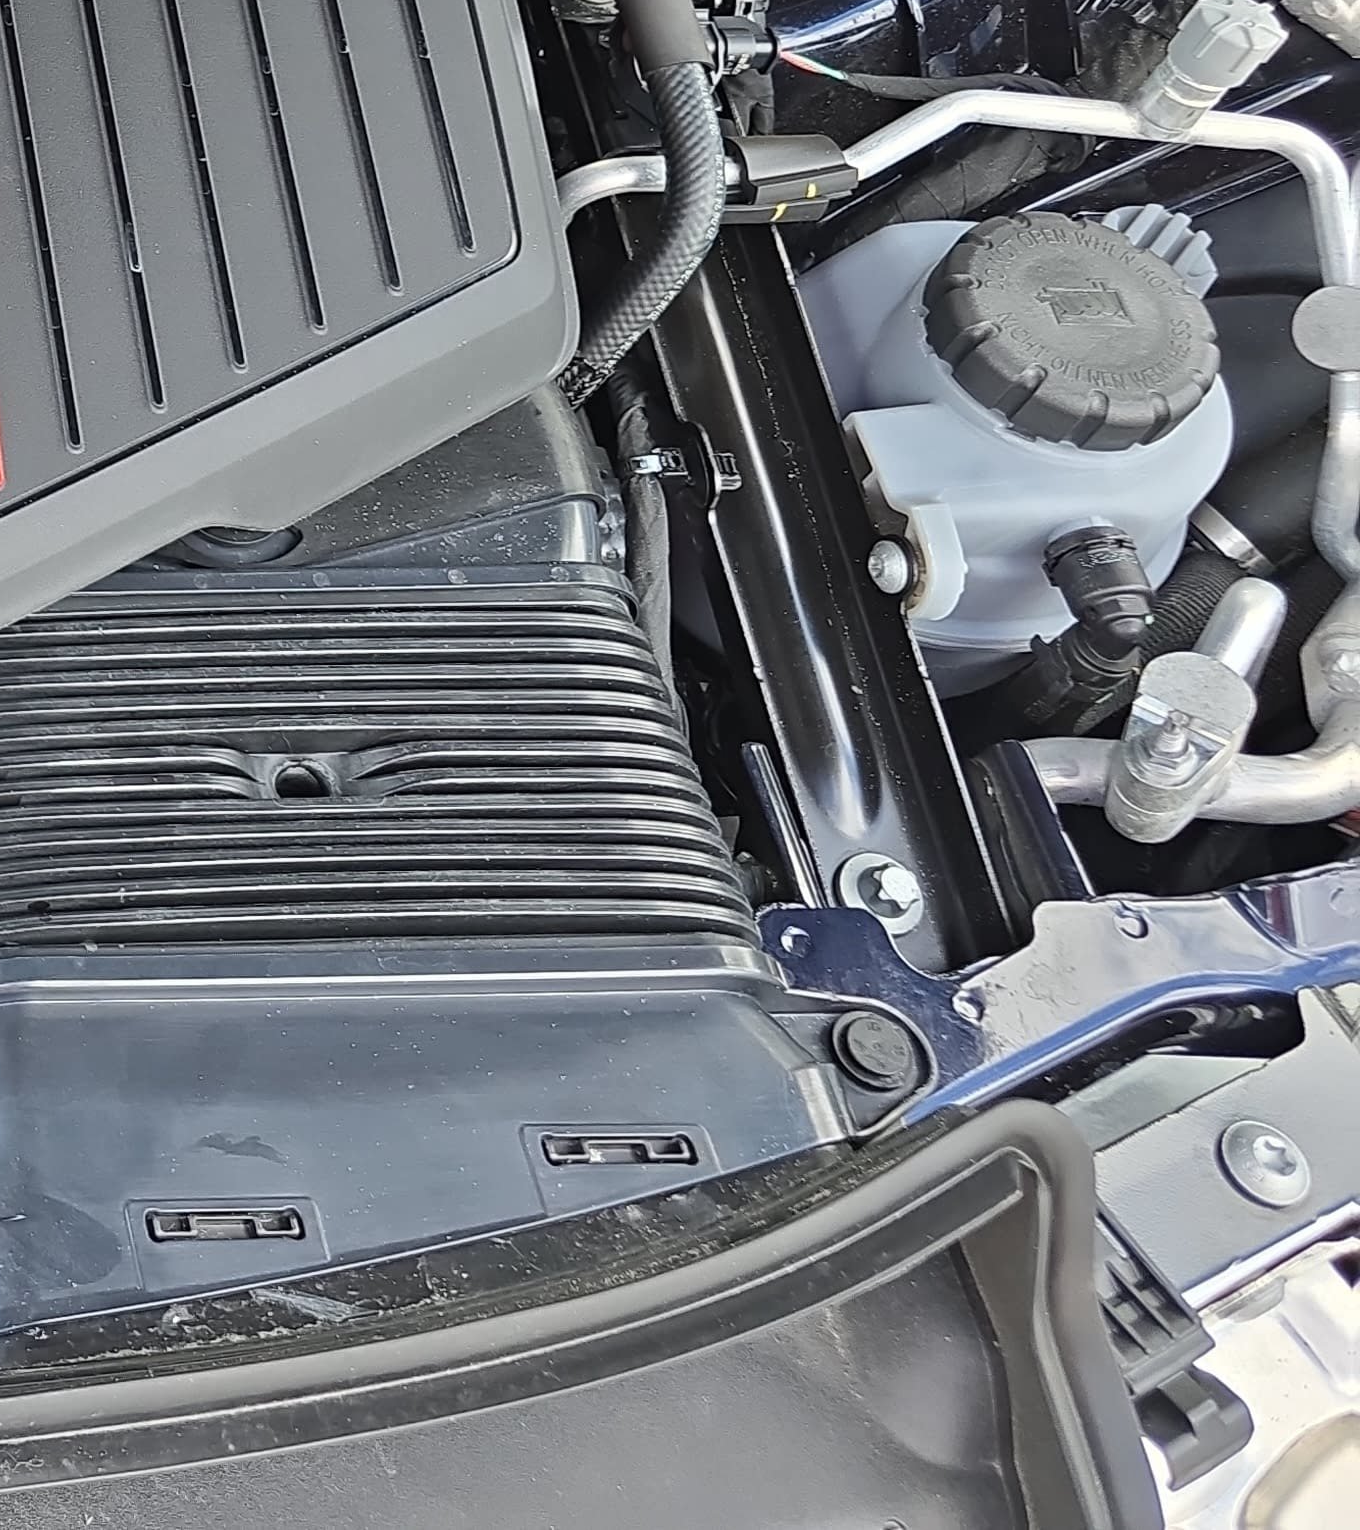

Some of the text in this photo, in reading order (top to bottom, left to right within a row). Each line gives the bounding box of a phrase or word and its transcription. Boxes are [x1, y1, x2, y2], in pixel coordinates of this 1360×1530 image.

[1017, 228, 1070, 248] OPEN
[1074, 230, 1136, 265] WHEN
[999, 312, 1048, 358] NICHT
